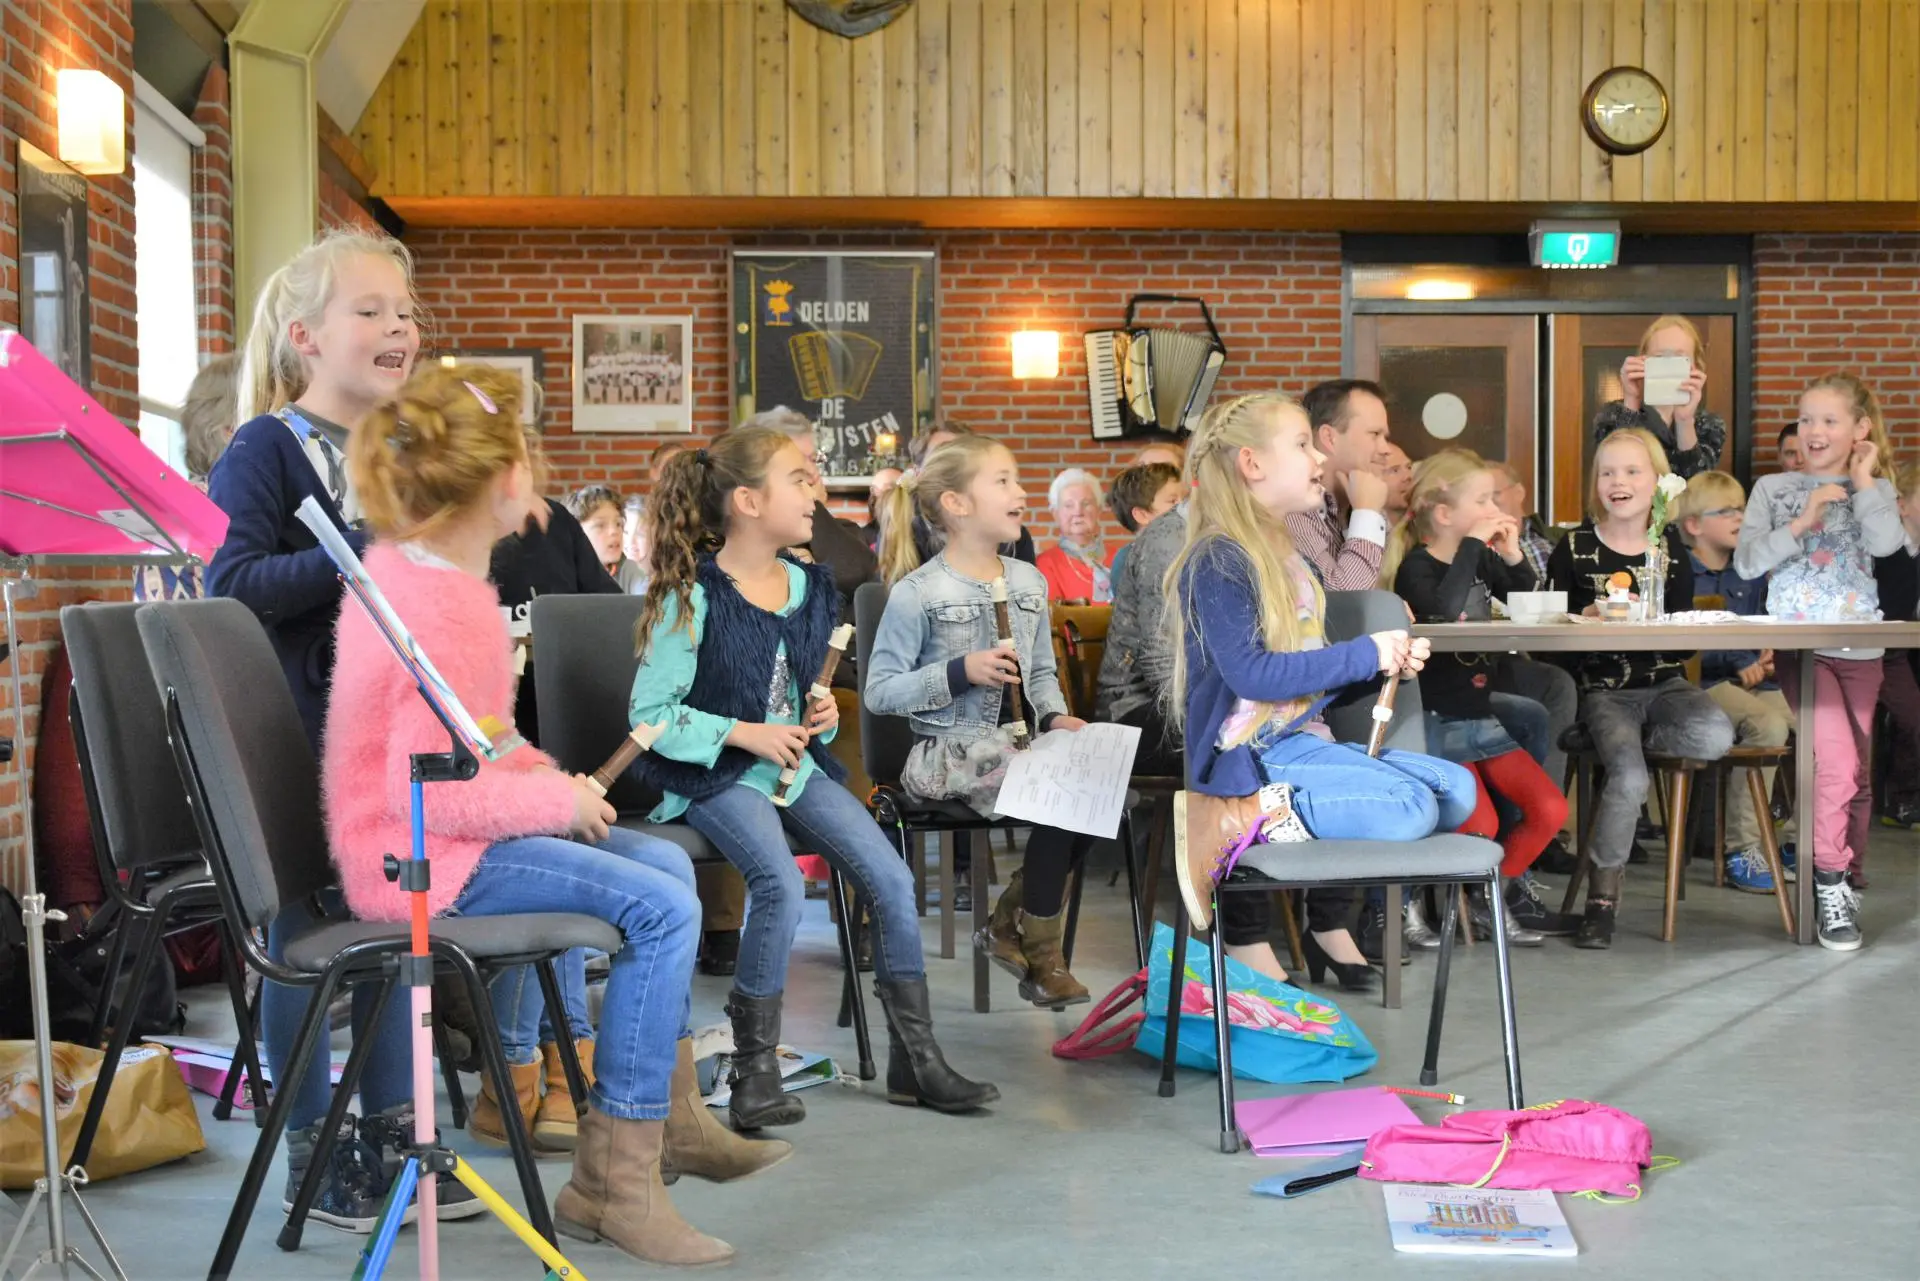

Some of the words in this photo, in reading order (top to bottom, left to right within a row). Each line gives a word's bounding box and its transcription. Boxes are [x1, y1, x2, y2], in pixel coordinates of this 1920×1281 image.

[801, 301, 870, 323] DELDEN
[821, 398, 846, 419] DE
[836, 411, 900, 449] ISTEN
